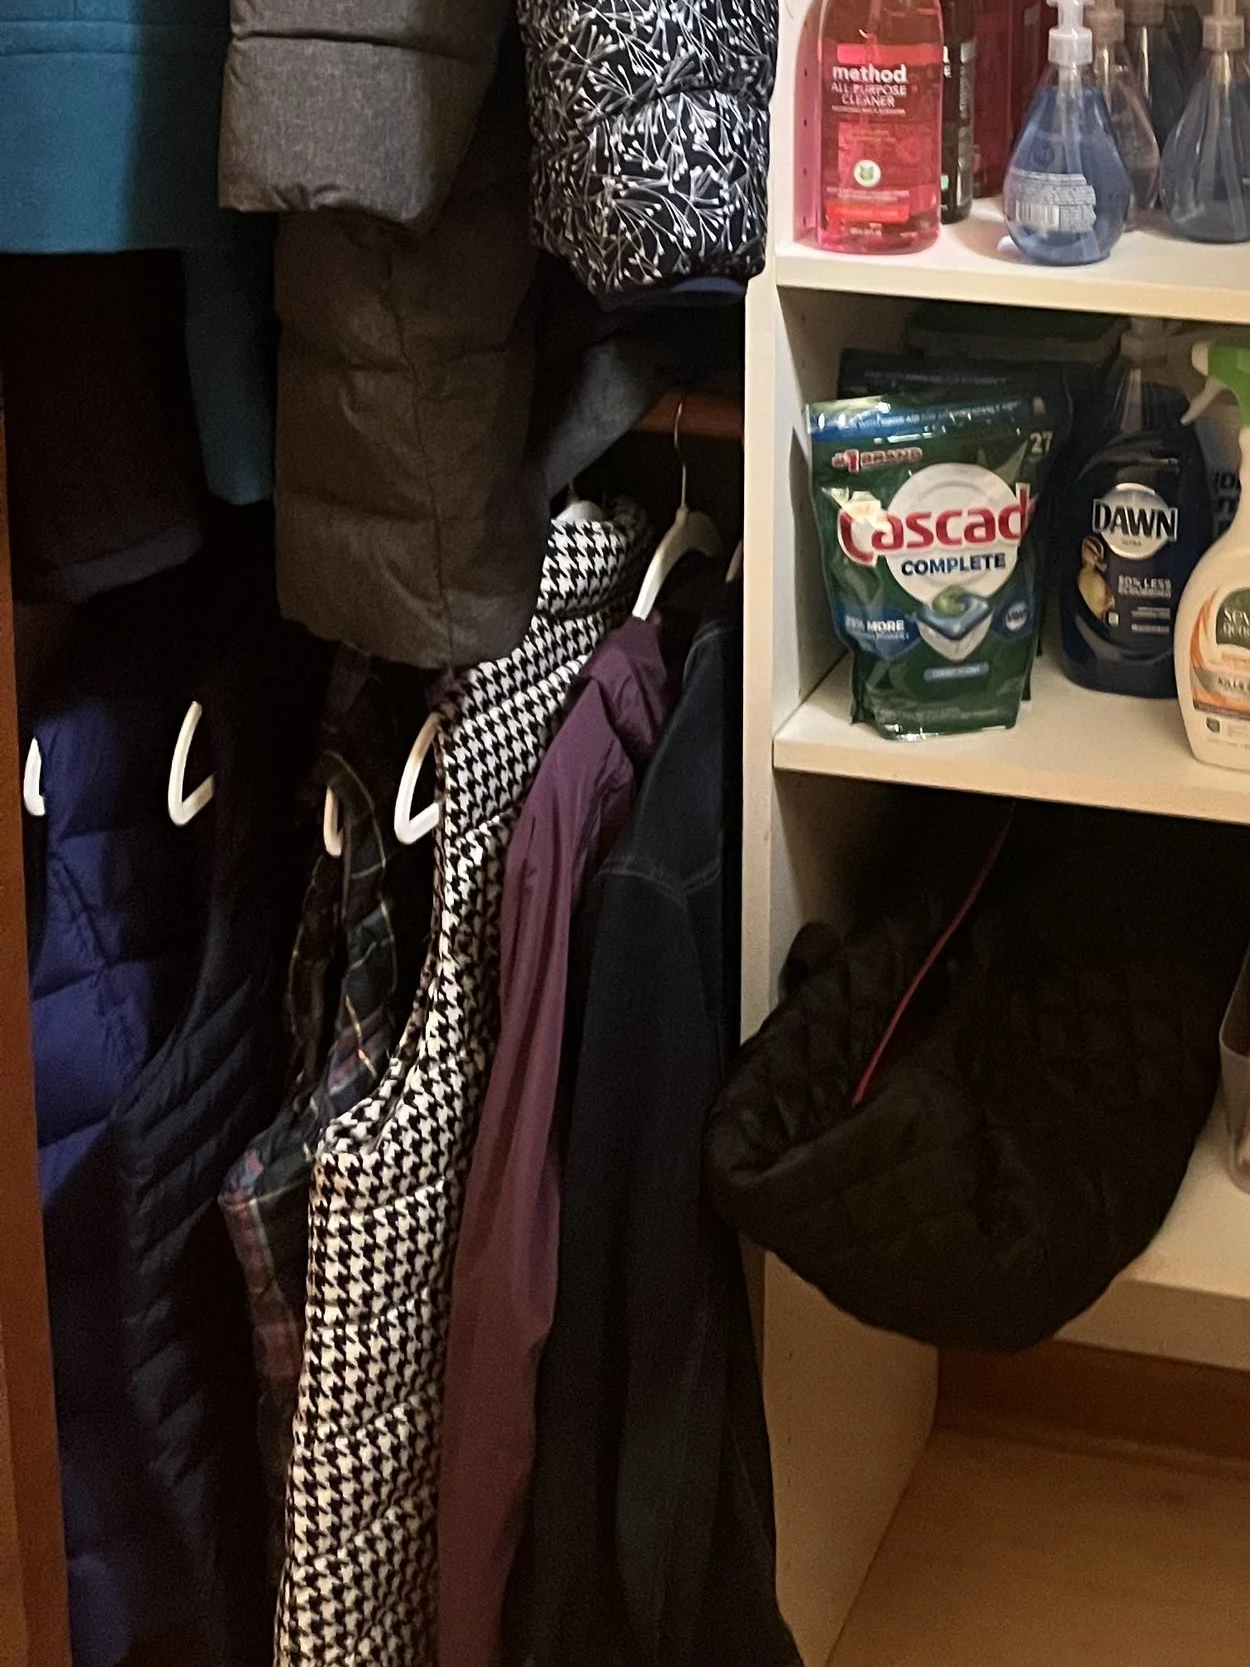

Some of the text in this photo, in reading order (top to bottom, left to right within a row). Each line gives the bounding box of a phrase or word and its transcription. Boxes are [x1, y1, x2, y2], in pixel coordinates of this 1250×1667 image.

[832, 63, 909, 84] method
[831, 82, 907, 97] ALL PURPOSE
[842, 94, 895, 107] CLEANER
[837, 484, 1036, 565] Cascad
[1093, 498, 1179, 542] DAWN
[901, 552, 1006, 576] COMPLETE
[866, 619, 905, 632] MORE
